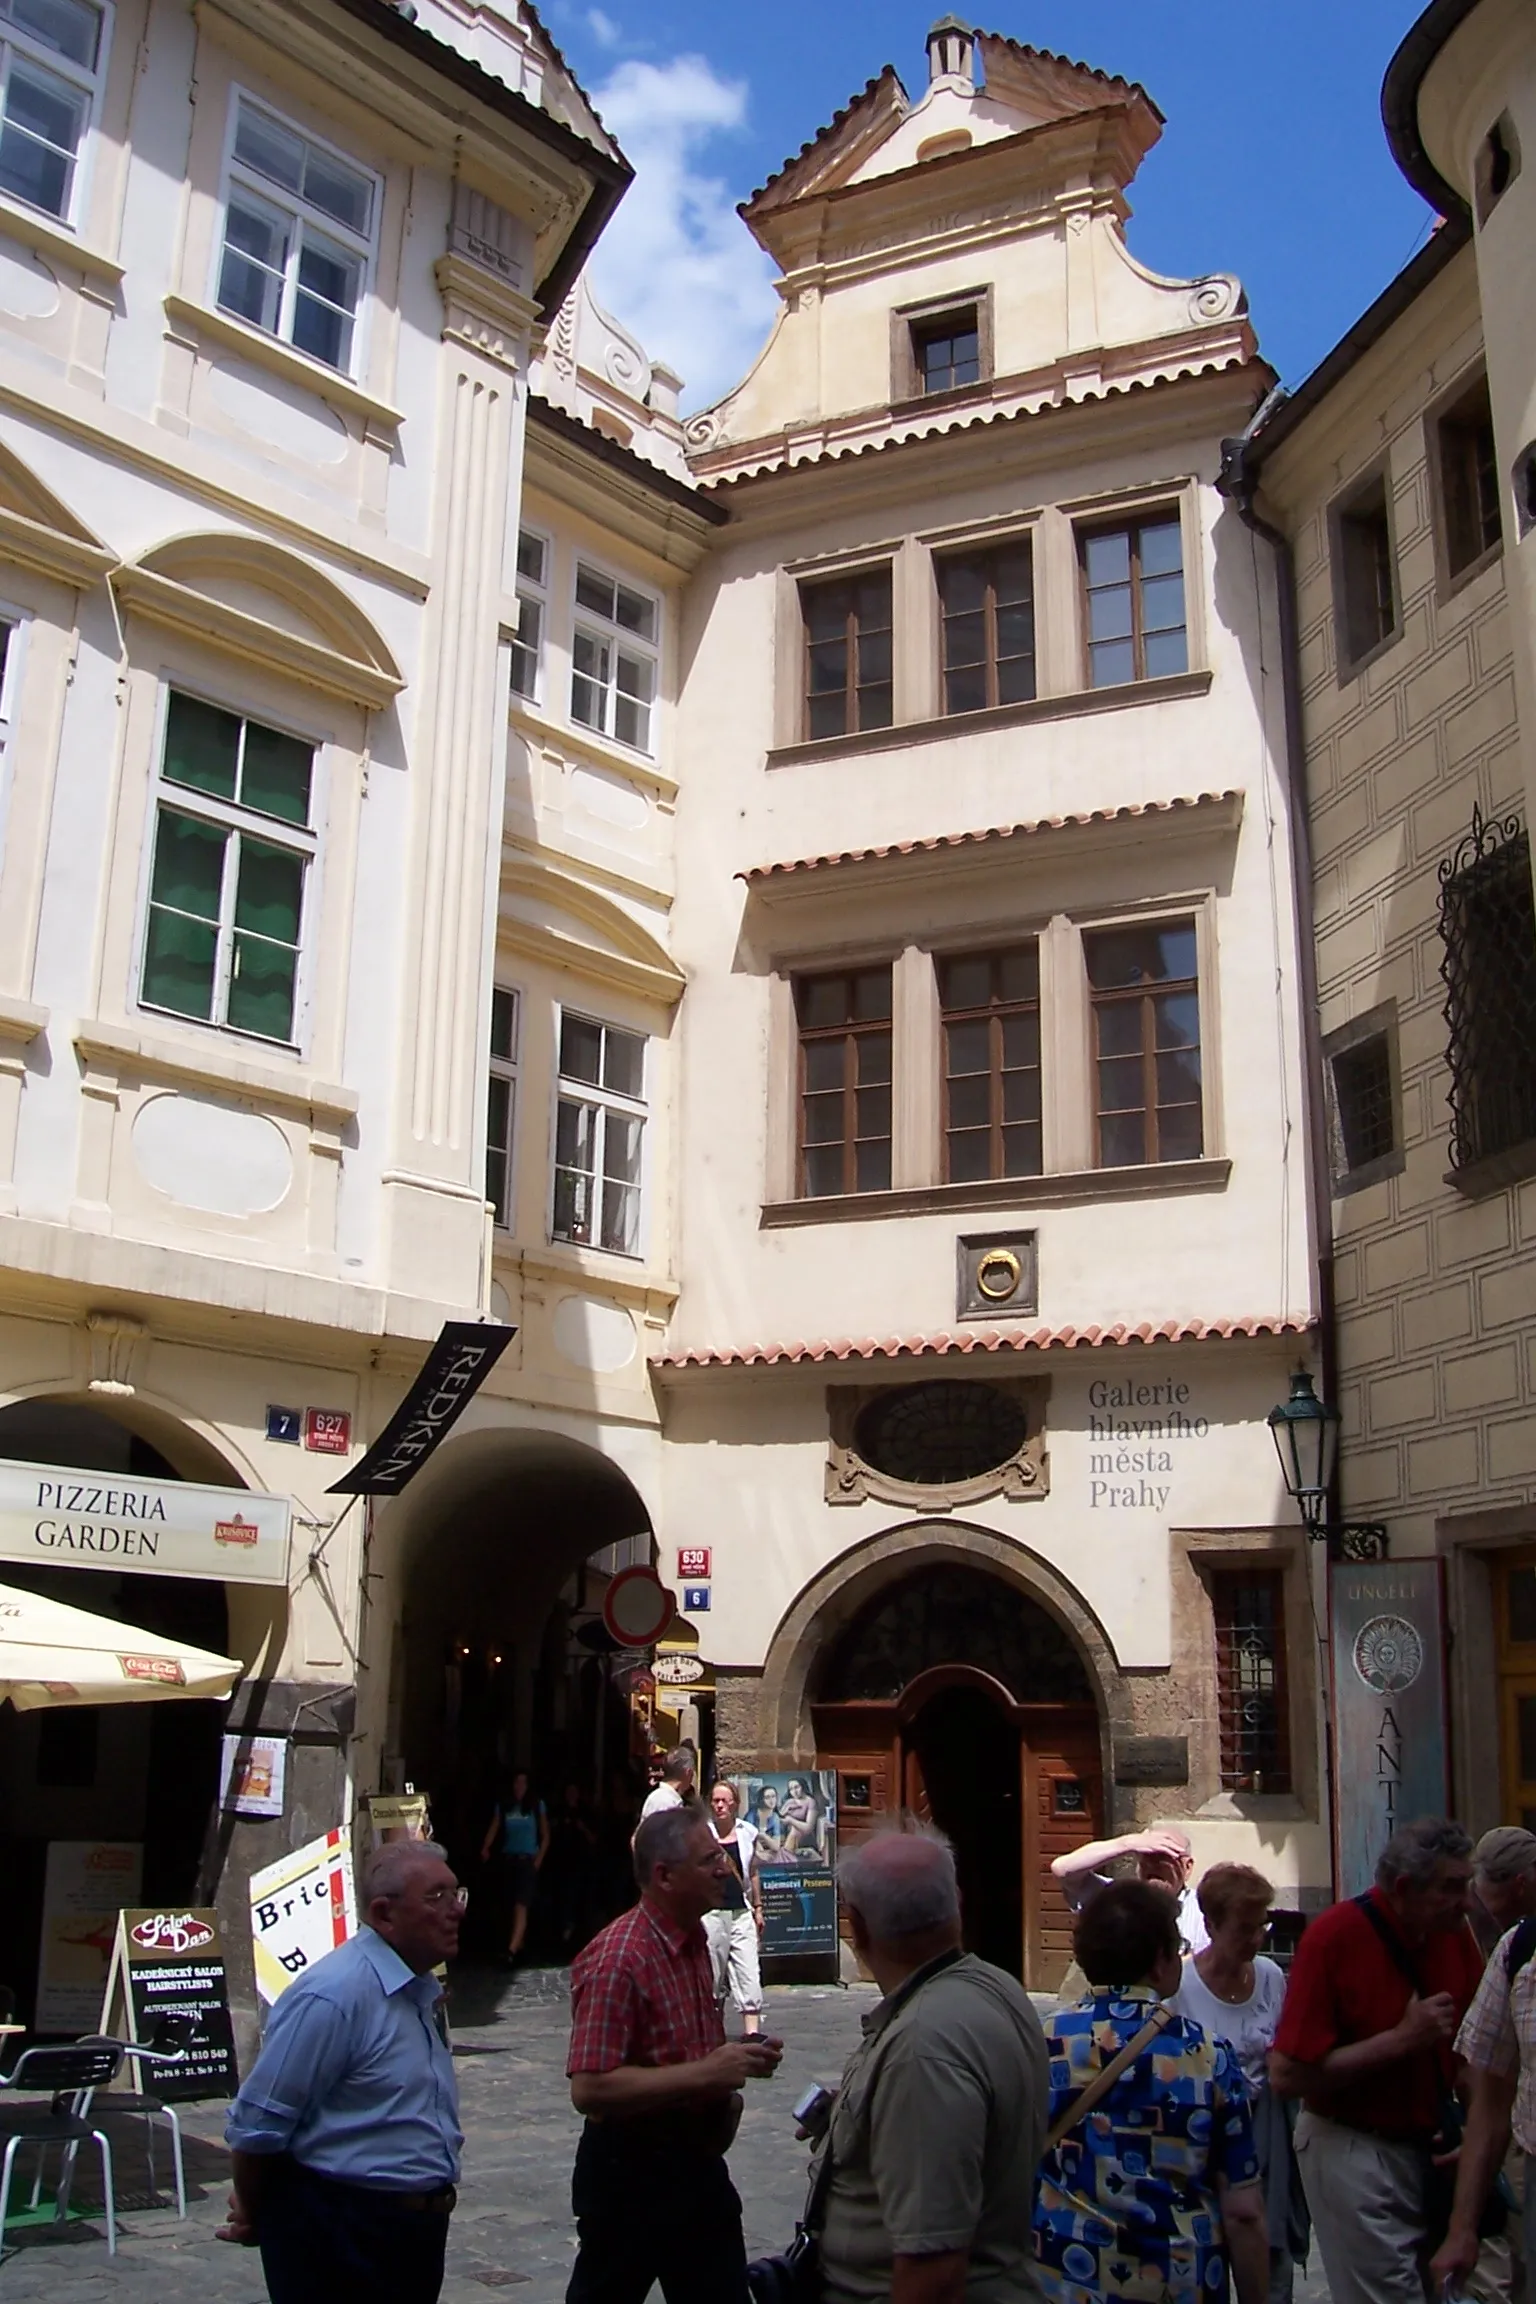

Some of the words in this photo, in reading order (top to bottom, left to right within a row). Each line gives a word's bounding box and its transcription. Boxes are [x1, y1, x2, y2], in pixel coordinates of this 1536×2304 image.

[1089, 1377, 1190, 1409] Galerie
[280, 1415, 290, 1434] 7
[315, 1413, 343, 1434] 627
[371, 1346, 488, 1481] REDKEN
[1088, 1411, 1209, 1441] hlavního
[1089, 1446, 1173, 1474] města
[36, 1482, 168, 1522] PIZZERIA
[1089, 1479, 1171, 1513] Prahy
[34, 1521, 160, 1557] GARDEN
[683, 1551, 704, 1564] 630
[692, 1592, 700, 1605] 6
[256, 1882, 328, 1931] Bric
[141, 1913, 194, 1947] Salon
[173, 1928, 210, 1952] Dan
[146, 1979, 214, 1992] HAIRSTYLISTS
[194, 1966, 224, 1977] SALON
[191, 2051, 209, 2061] 810
[210, 2049, 228, 2060] 549
